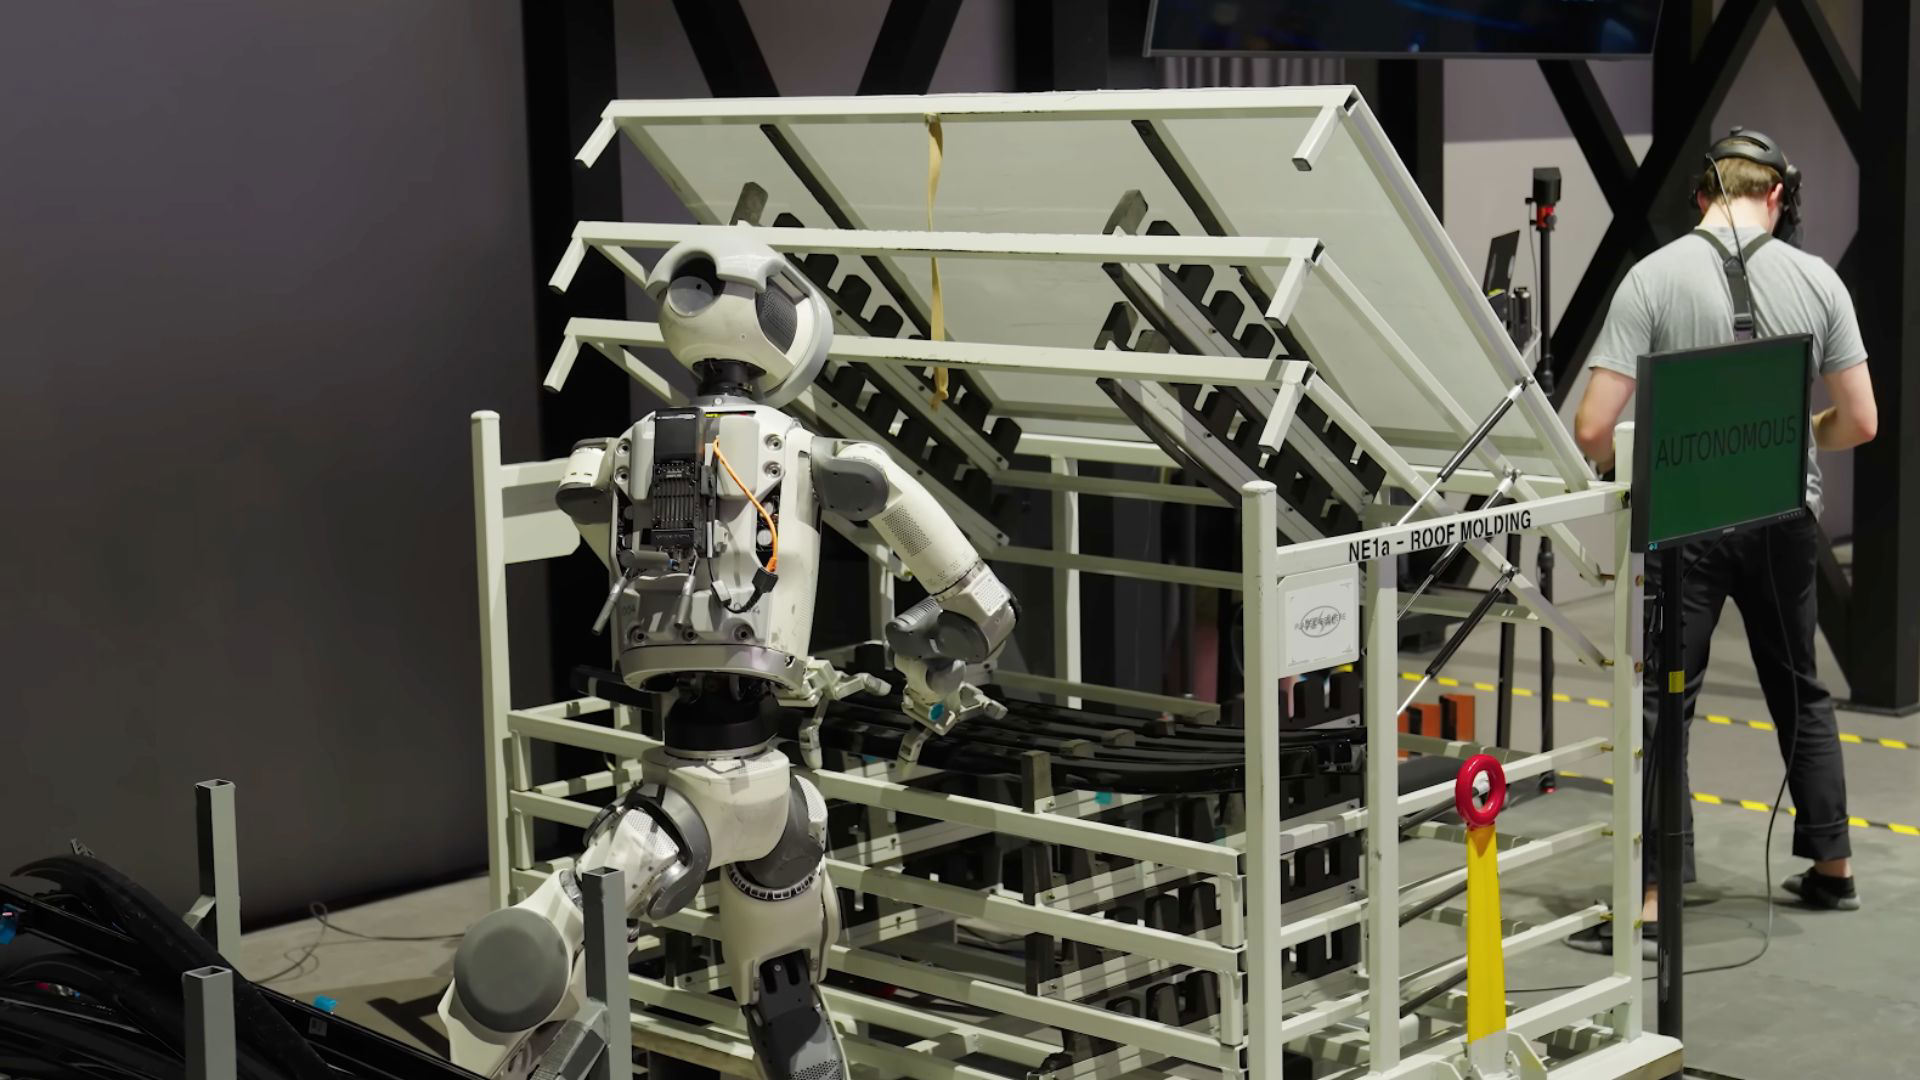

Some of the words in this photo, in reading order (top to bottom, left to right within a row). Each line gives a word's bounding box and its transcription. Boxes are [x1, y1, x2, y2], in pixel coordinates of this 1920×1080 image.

[1655, 415, 1797, 470] AUTONOMOUS
[1349, 538, 1390, 563] NE1a
[1410, 523, 1455, 551] ROOF
[1460, 509, 1532, 542] MOLDING
